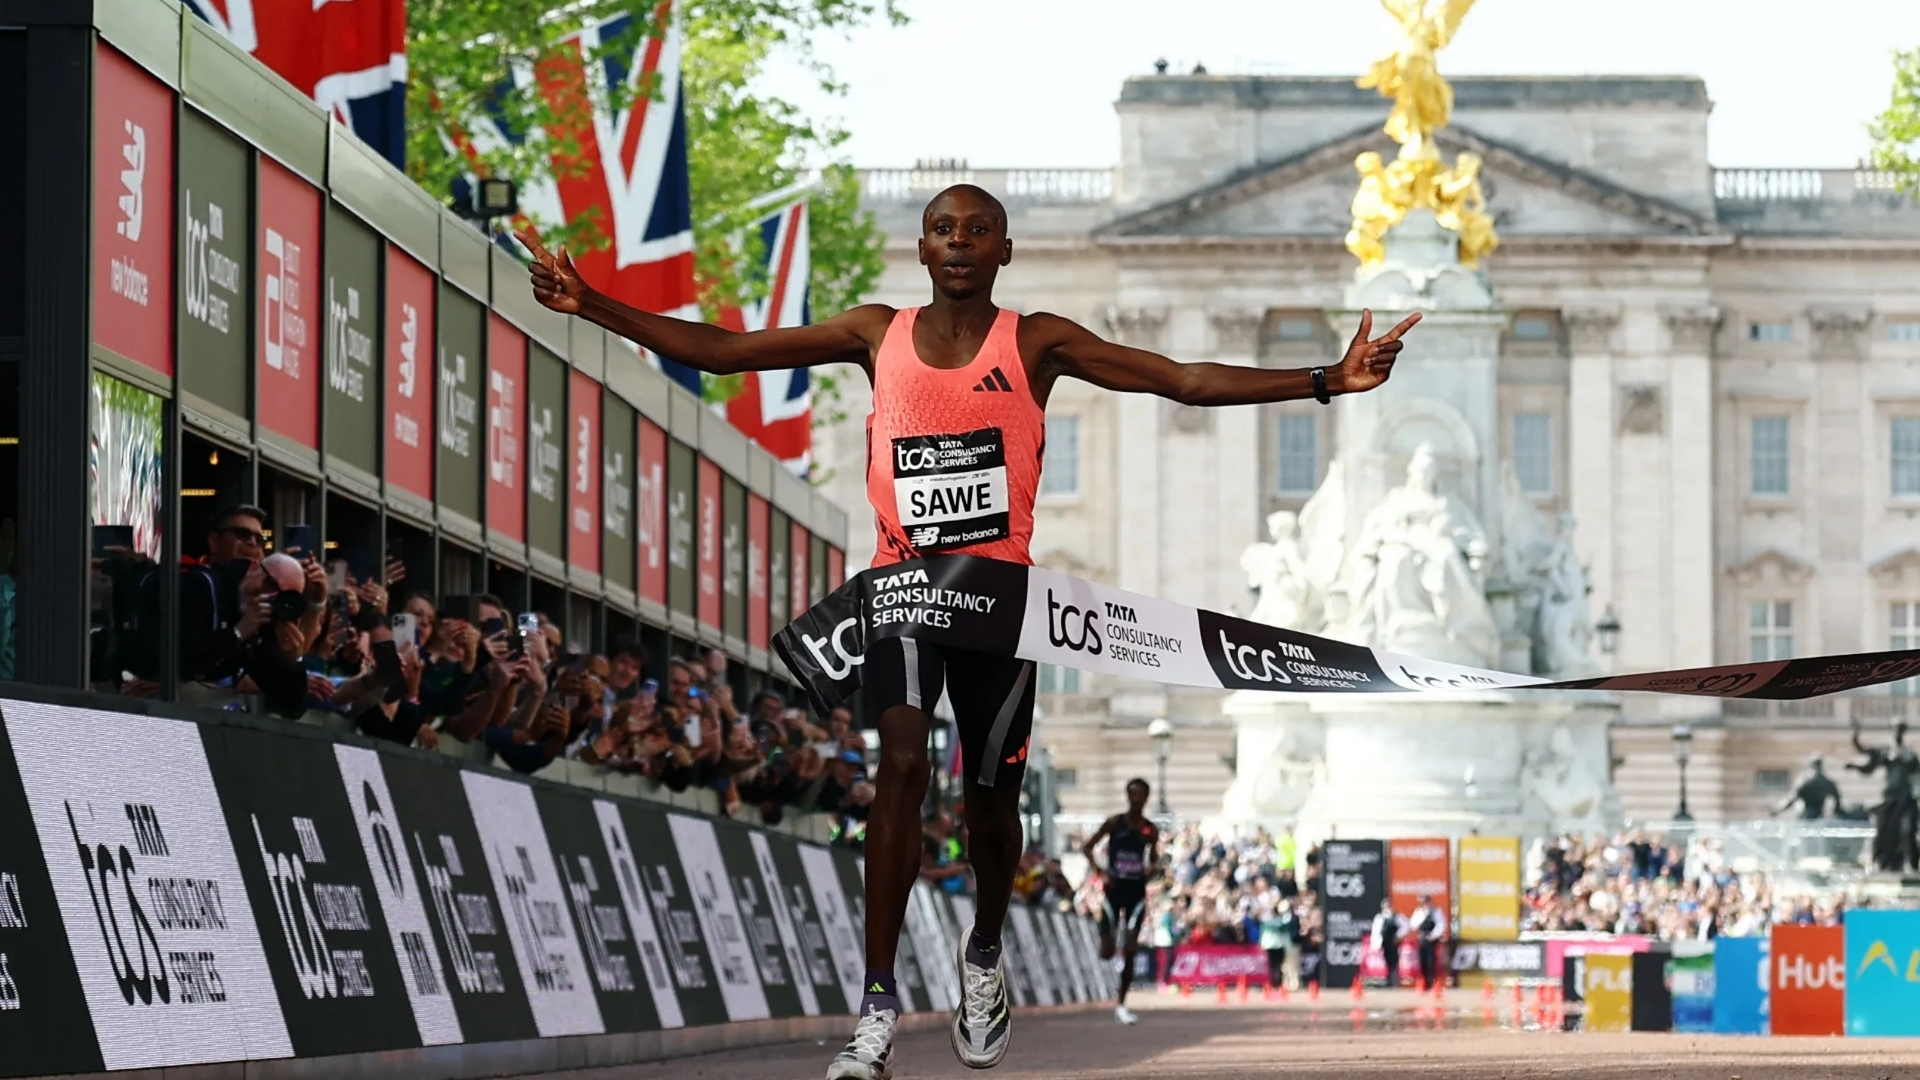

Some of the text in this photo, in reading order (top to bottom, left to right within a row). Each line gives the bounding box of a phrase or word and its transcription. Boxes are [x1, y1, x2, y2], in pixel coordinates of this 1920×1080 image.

[186, 188, 208, 322] tcs
[896, 444, 937, 471] tcs
[938, 440, 964, 450] TATA
[938, 443, 997, 459] CONSULTANCY
[939, 456, 978, 467] SERVICES
[910, 482, 992, 518] SAWE
[940, 527, 999, 545] new balance
[872, 568, 930, 592] TATA
[872, 588, 996, 614] CONSULTANCY
[1104, 602, 1138, 624] TATA
[872, 608, 952, 629] SERVICES
[1047, 587, 1103, 656] tcs
[1106, 623, 1183, 655] CONSULTANCY
[1278, 641, 1316, 662] TATA
[1109, 643, 1162, 669] SERVICES
[1219, 628, 1292, 685] tcs
[1286, 660, 1372, 684] CONSULTANCY
[1297, 675, 1357, 690] SERVICES
[124, 803, 170, 856] TATA
[1326, 873, 1366, 898] tcs
[65, 799, 171, 1006] tcs
[148, 877, 228, 931] CONSULTANCY
[251, 813, 339, 1000] tcs
[169, 951, 226, 1003] SERVICES
